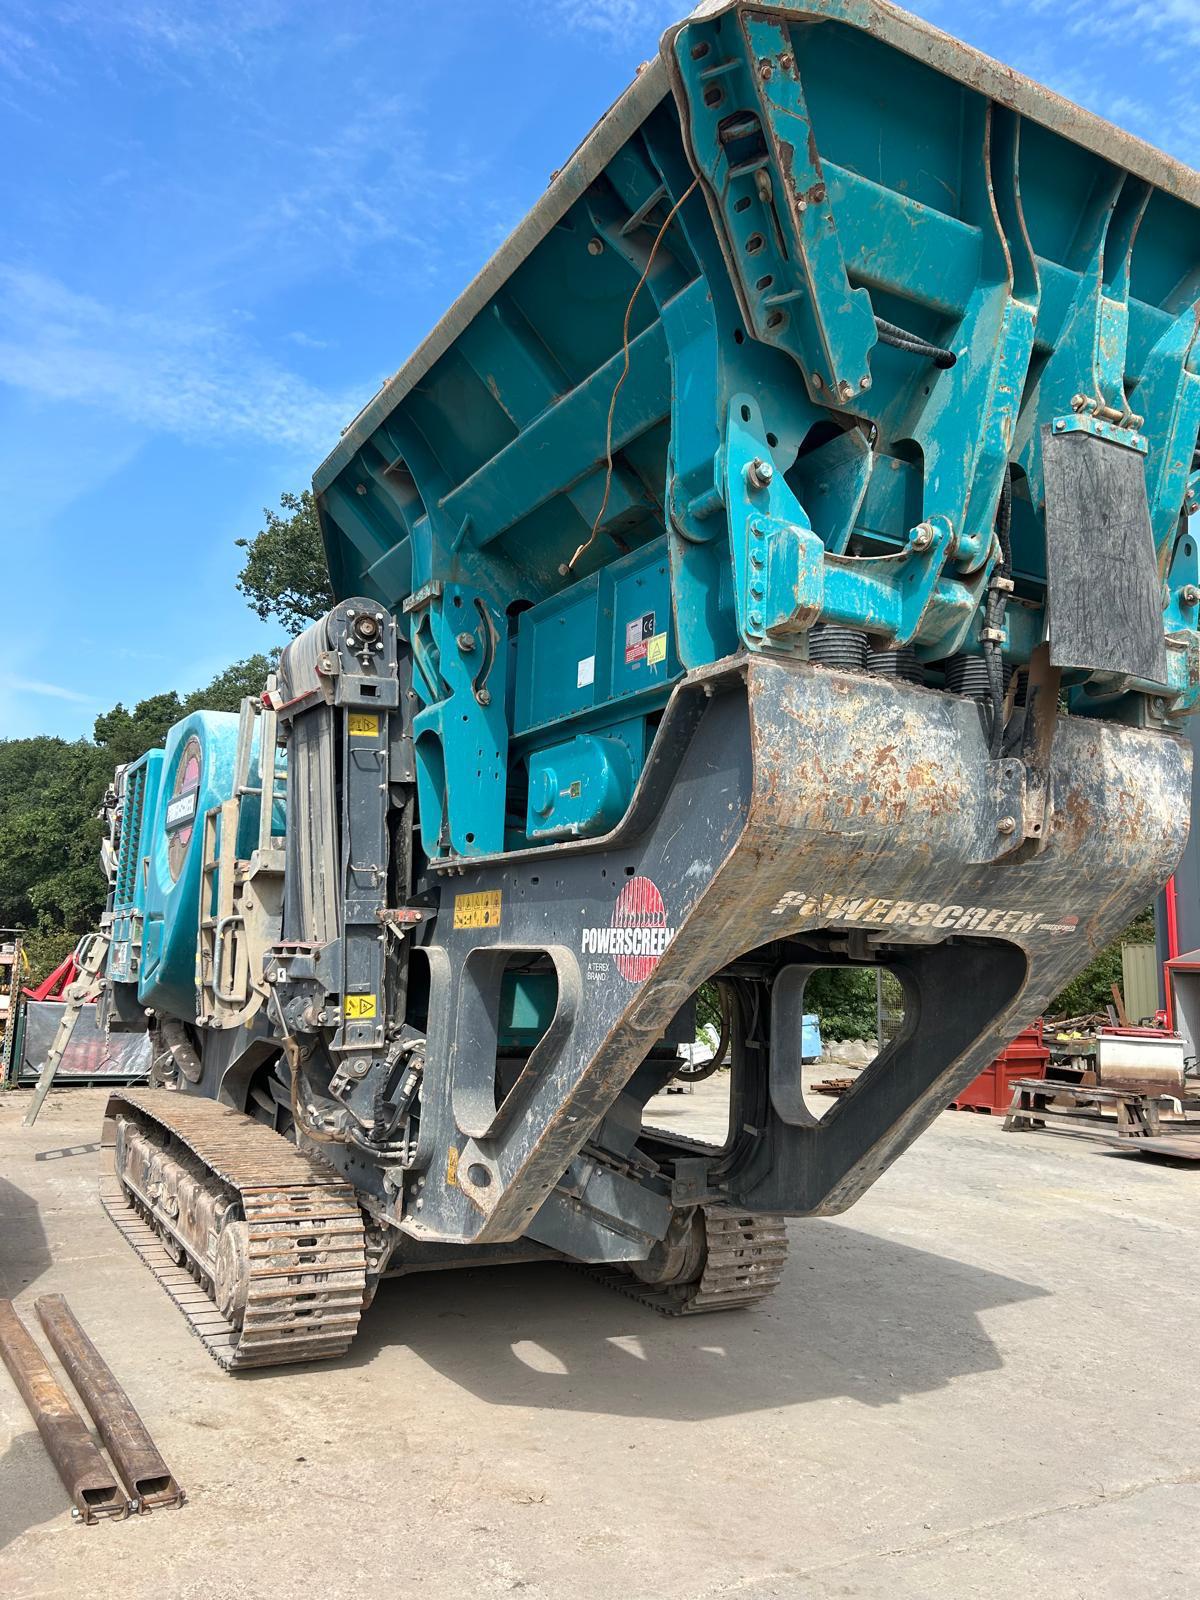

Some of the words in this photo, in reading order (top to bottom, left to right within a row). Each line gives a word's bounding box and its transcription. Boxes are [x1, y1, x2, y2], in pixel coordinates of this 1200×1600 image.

[770, 891, 1044, 933] POWERSCREEN
[592, 963, 609, 972] TEREX
[587, 971, 606, 981] BRAND
